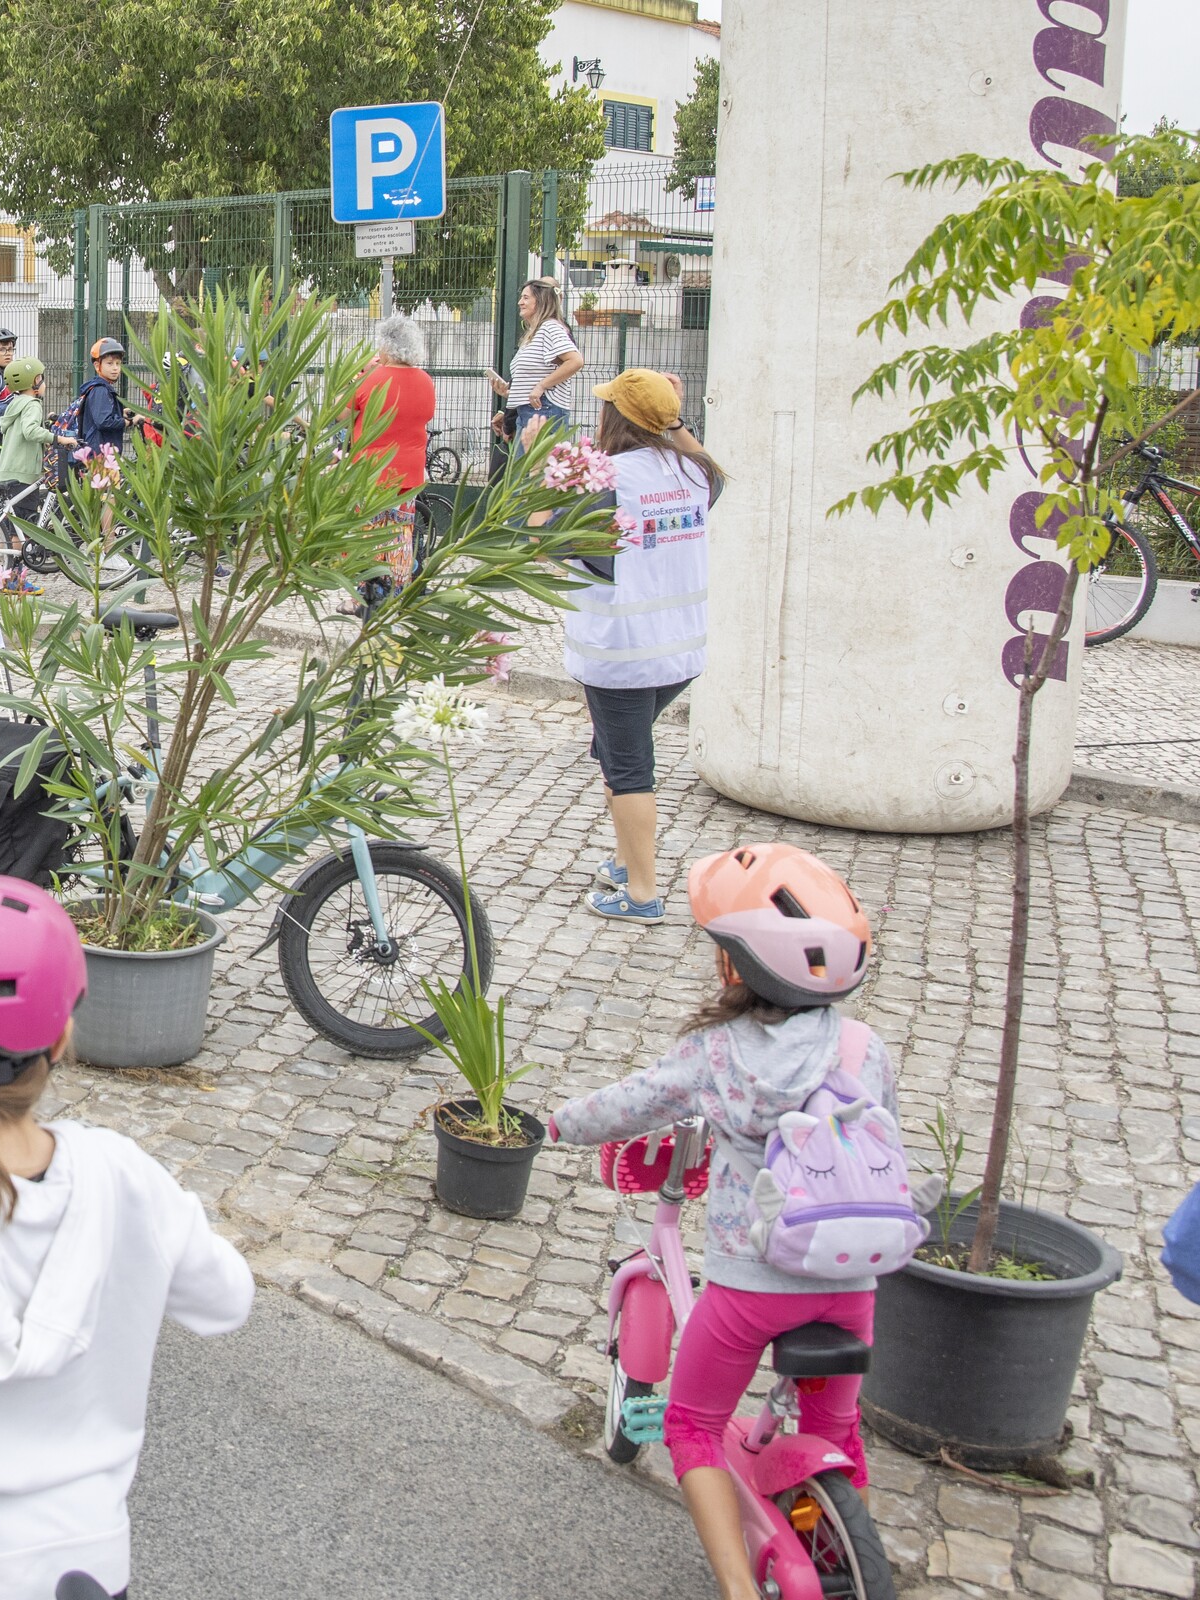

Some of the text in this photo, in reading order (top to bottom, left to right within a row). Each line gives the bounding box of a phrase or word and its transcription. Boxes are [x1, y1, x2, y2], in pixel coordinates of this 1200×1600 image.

[355, 118, 417, 210] P
[640, 489, 692, 505] MAQUINISTA
[641, 505, 691, 518] CicloExpresso
